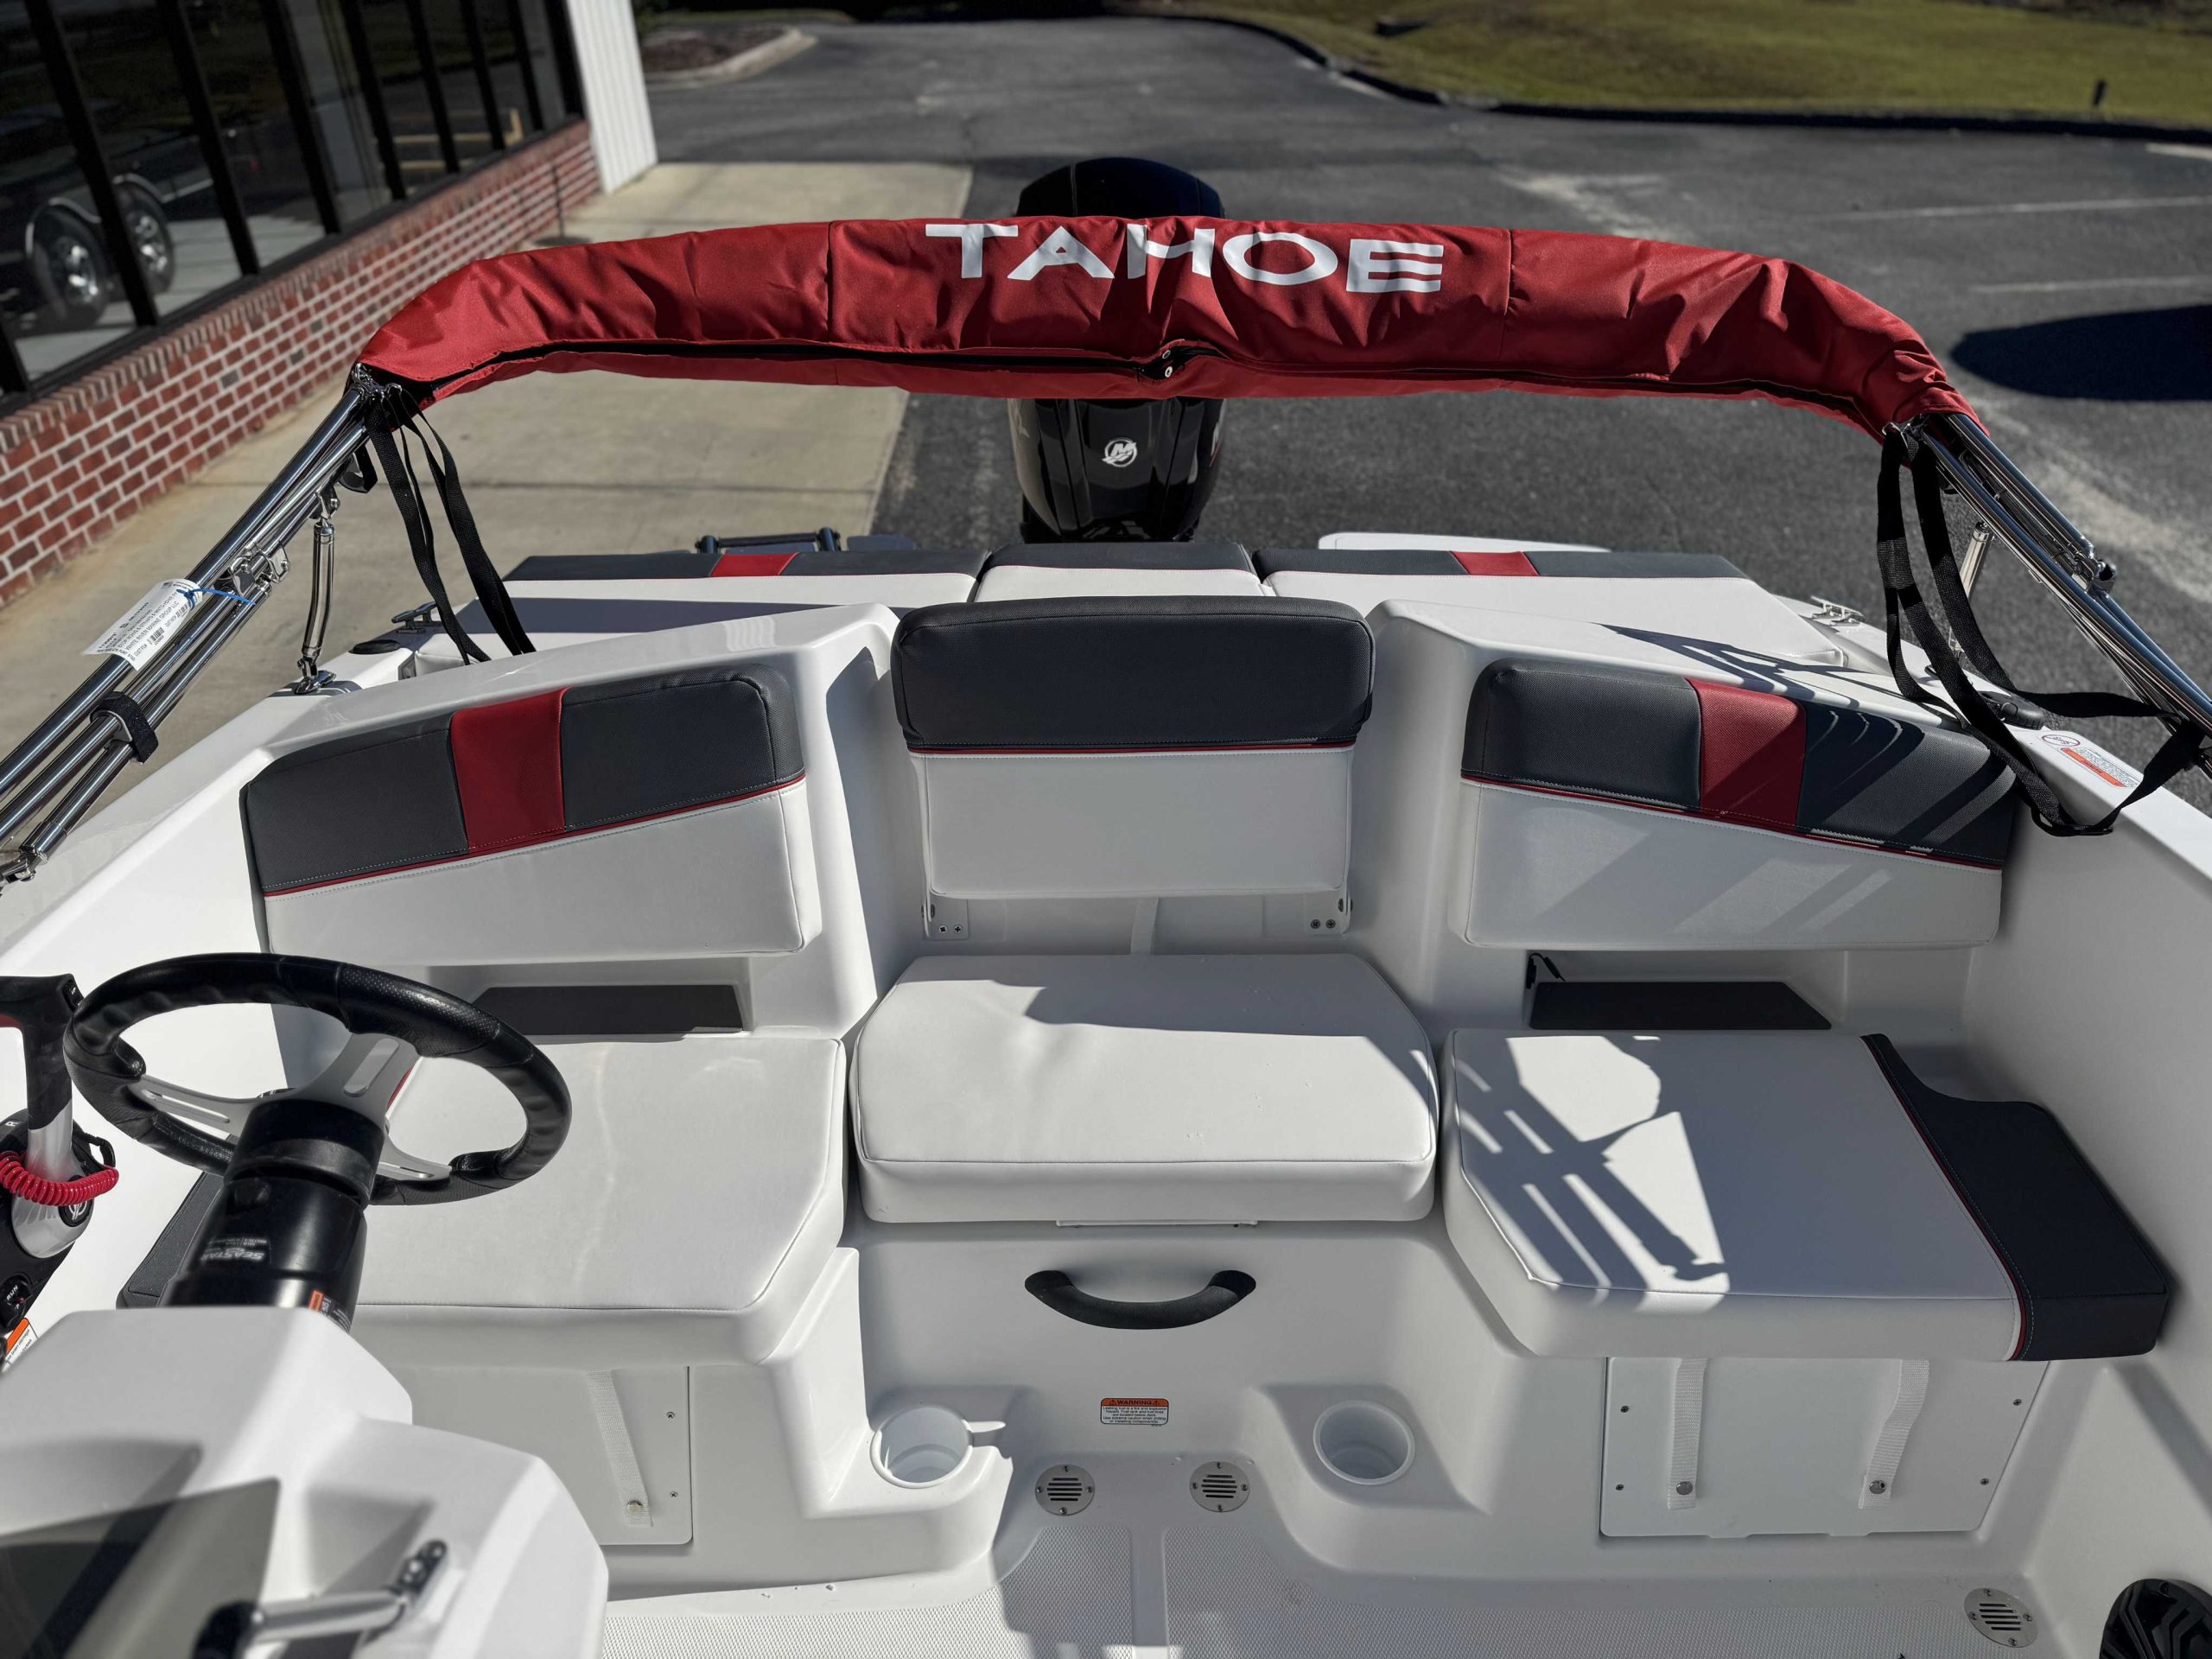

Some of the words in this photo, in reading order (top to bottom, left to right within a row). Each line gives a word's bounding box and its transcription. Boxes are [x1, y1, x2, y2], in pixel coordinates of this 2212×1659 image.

[925, 223, 1444, 293] TAHOE
[137, 629, 148, 641] RIVER
[147, 618, 161, 631] MARINE
[160, 607, 172, 619] GROUP
[200, 1251, 264, 1262] SEASTAR
[6, 1284, 18, 1300] RUN
